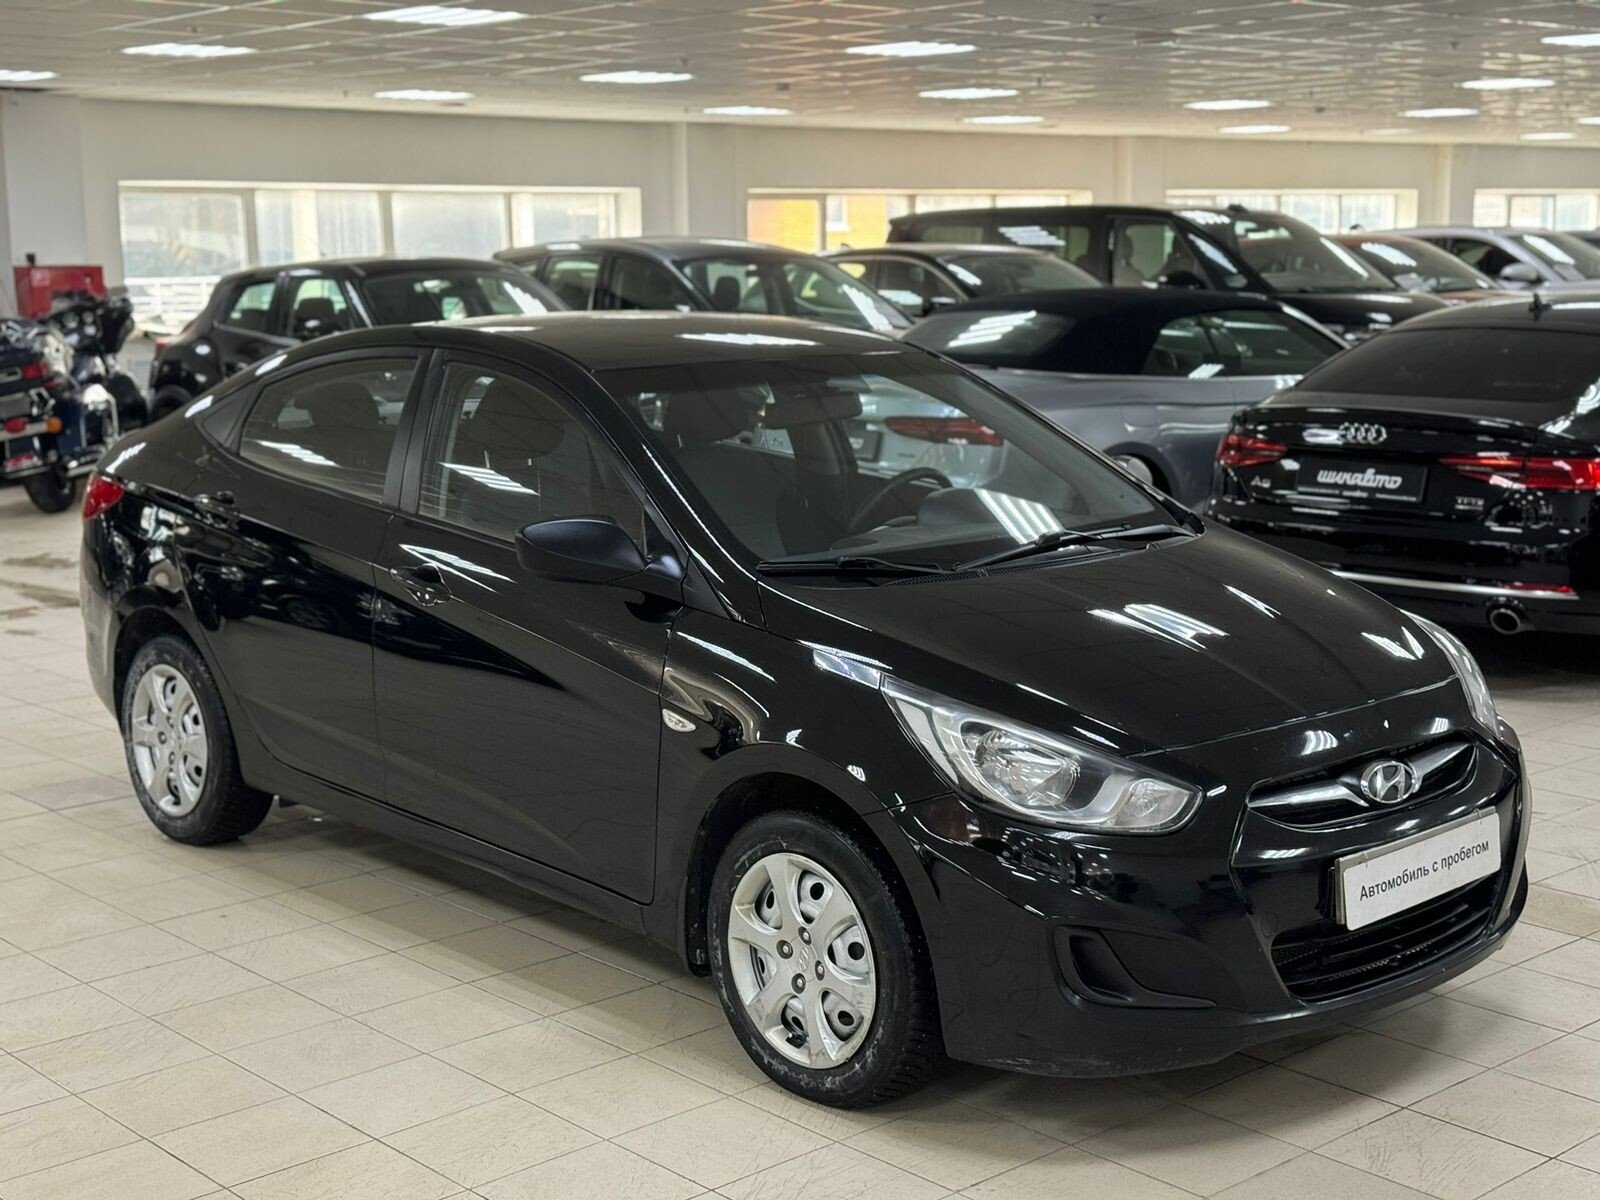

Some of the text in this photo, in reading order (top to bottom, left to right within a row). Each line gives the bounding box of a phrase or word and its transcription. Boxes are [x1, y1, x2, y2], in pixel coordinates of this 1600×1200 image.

[1360, 840, 1490, 901] Автомобиль с пробегом
